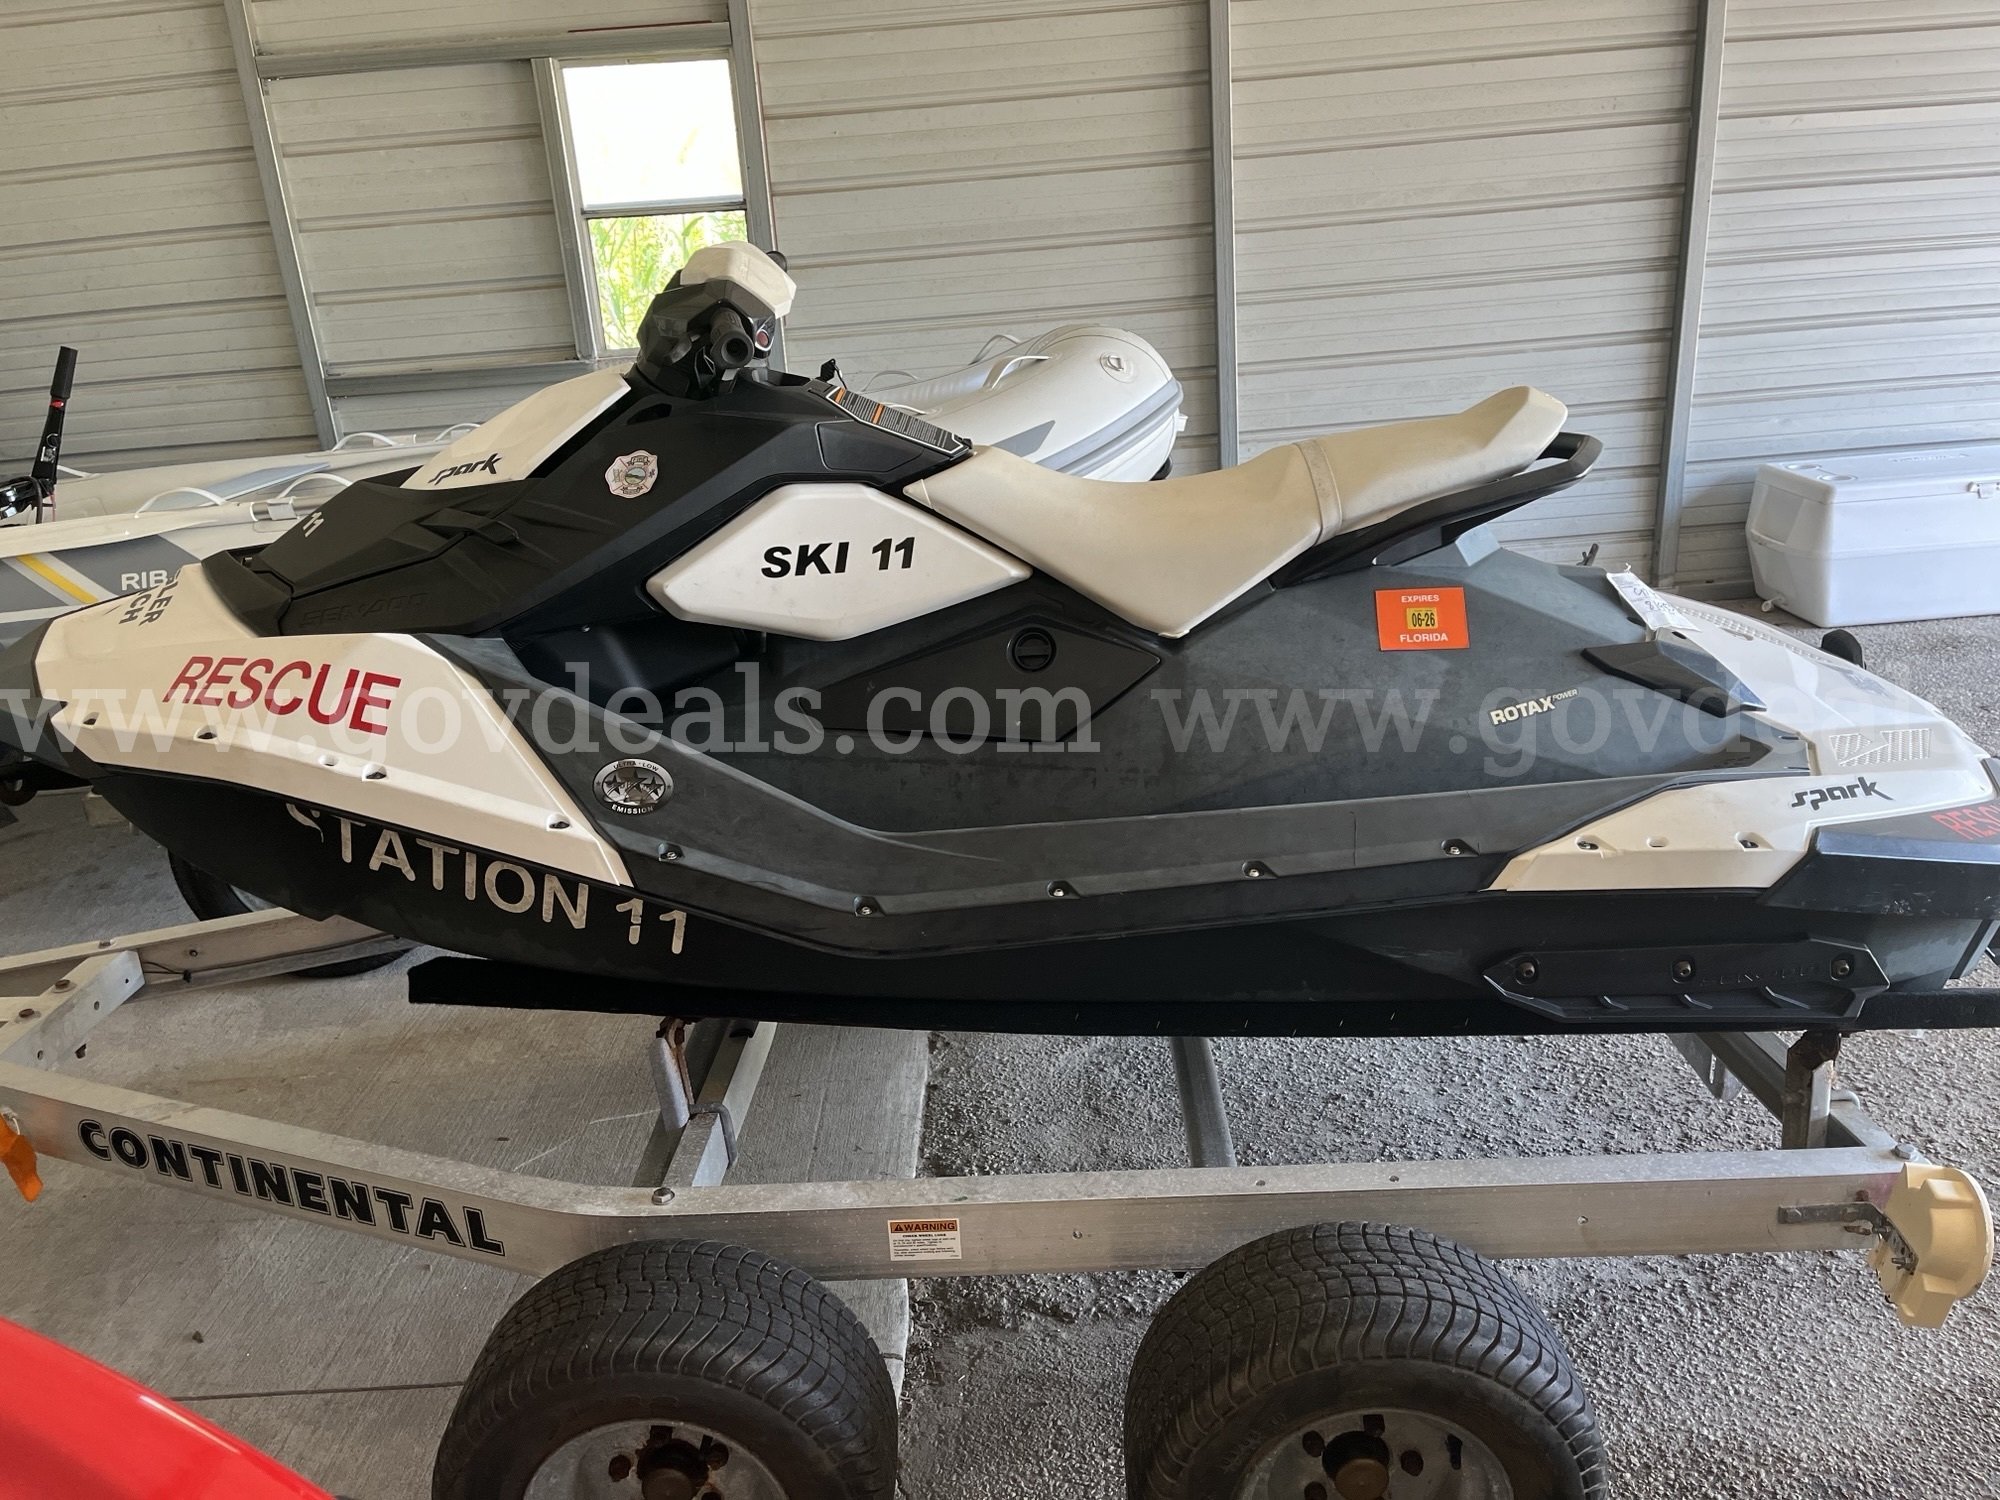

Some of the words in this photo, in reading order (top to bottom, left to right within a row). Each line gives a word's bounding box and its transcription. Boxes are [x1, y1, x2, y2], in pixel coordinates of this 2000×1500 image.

[761, 541, 849, 578] SKI
[872, 537, 915, 570] 11
[121, 570, 168, 591] RIB
[1401, 594, 1440, 603] EXPIRES
[1411, 612, 1436, 628] 06-26
[1400, 632, 1449, 643] FLORIDA
[163, 656, 401, 735] RESCUE
[1490, 695, 1556, 725] ROTAX
[1552, 688, 1578, 702] POWER
[1791, 776, 1895, 811] spark
[611, 803, 654, 815] EMISSION
[616, 898, 687, 955] 11
[78, 1119, 505, 1257] CONTINENTAL
[904, 1222, 955, 1232] WARNING
